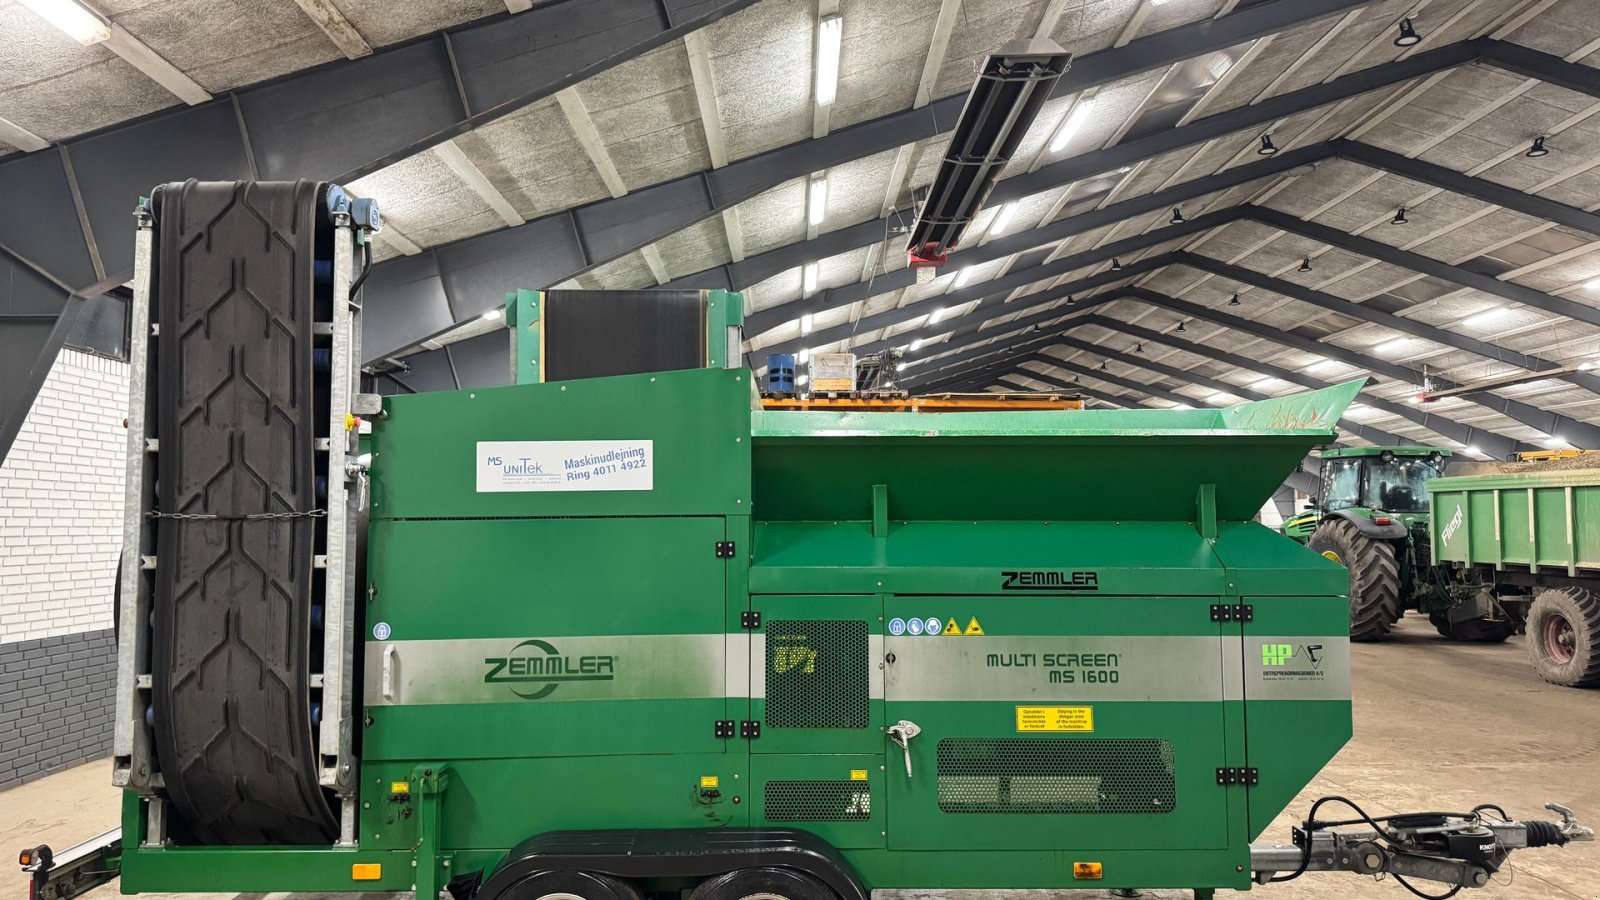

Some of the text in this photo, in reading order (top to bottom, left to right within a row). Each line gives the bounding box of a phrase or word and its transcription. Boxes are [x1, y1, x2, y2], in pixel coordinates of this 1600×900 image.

[487, 456, 502, 466] MS
[564, 446, 645, 470] Maskinudlejning
[566, 458, 646, 481] Ring 4011 4922
[1001, 571, 1098, 590] ZEMMLER
[986, 654, 1036, 667] MULTI
[1262, 644, 1292, 666] HP
[1049, 670, 1119, 684] MS 1600
